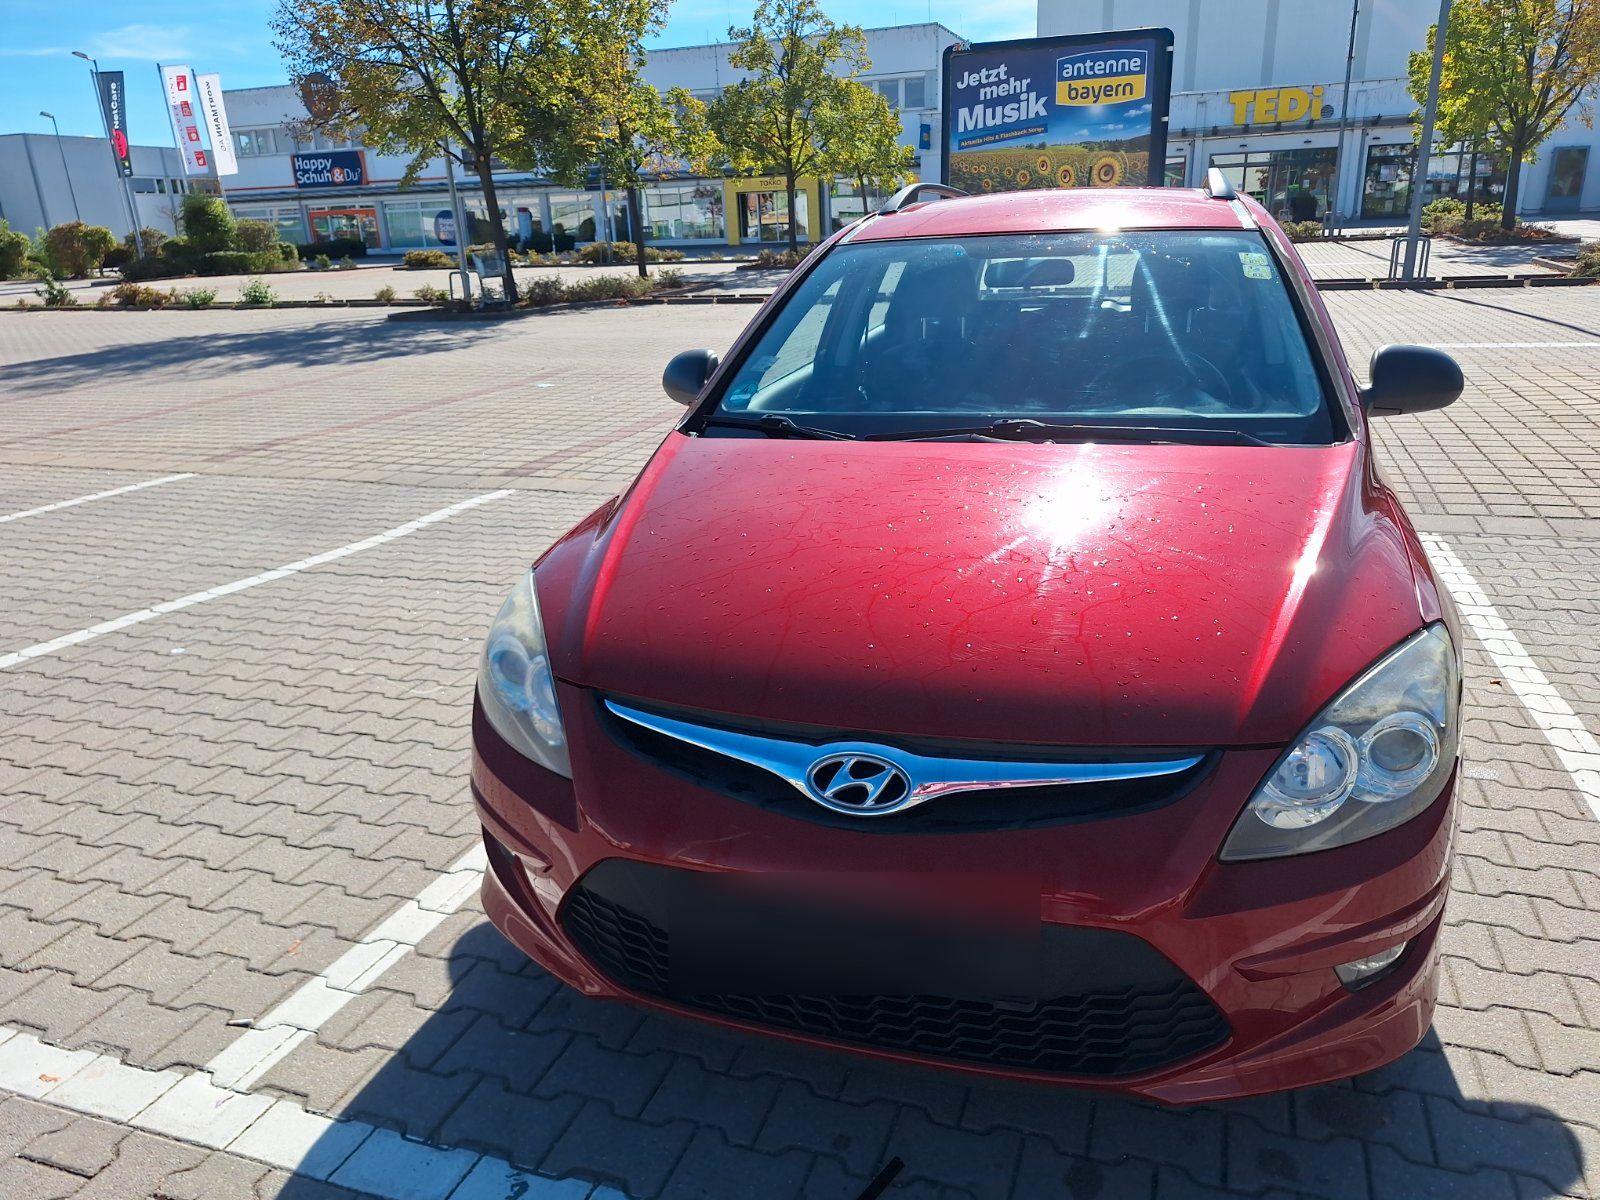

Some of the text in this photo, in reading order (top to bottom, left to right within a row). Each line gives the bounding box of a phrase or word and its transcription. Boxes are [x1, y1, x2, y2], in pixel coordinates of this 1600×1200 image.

[956, 63, 1008, 90] Jetzt
[1062, 57, 1141, 78] antenne
[979, 76, 1031, 100] mehr
[1067, 81, 1134, 104] bayern
[957, 92, 1049, 133] Musik
[1229, 85, 1324, 125] TEDi
[294, 157, 332, 171] Happy
[296, 170, 332, 184] Schuh
[333, 167, 344, 182] &
